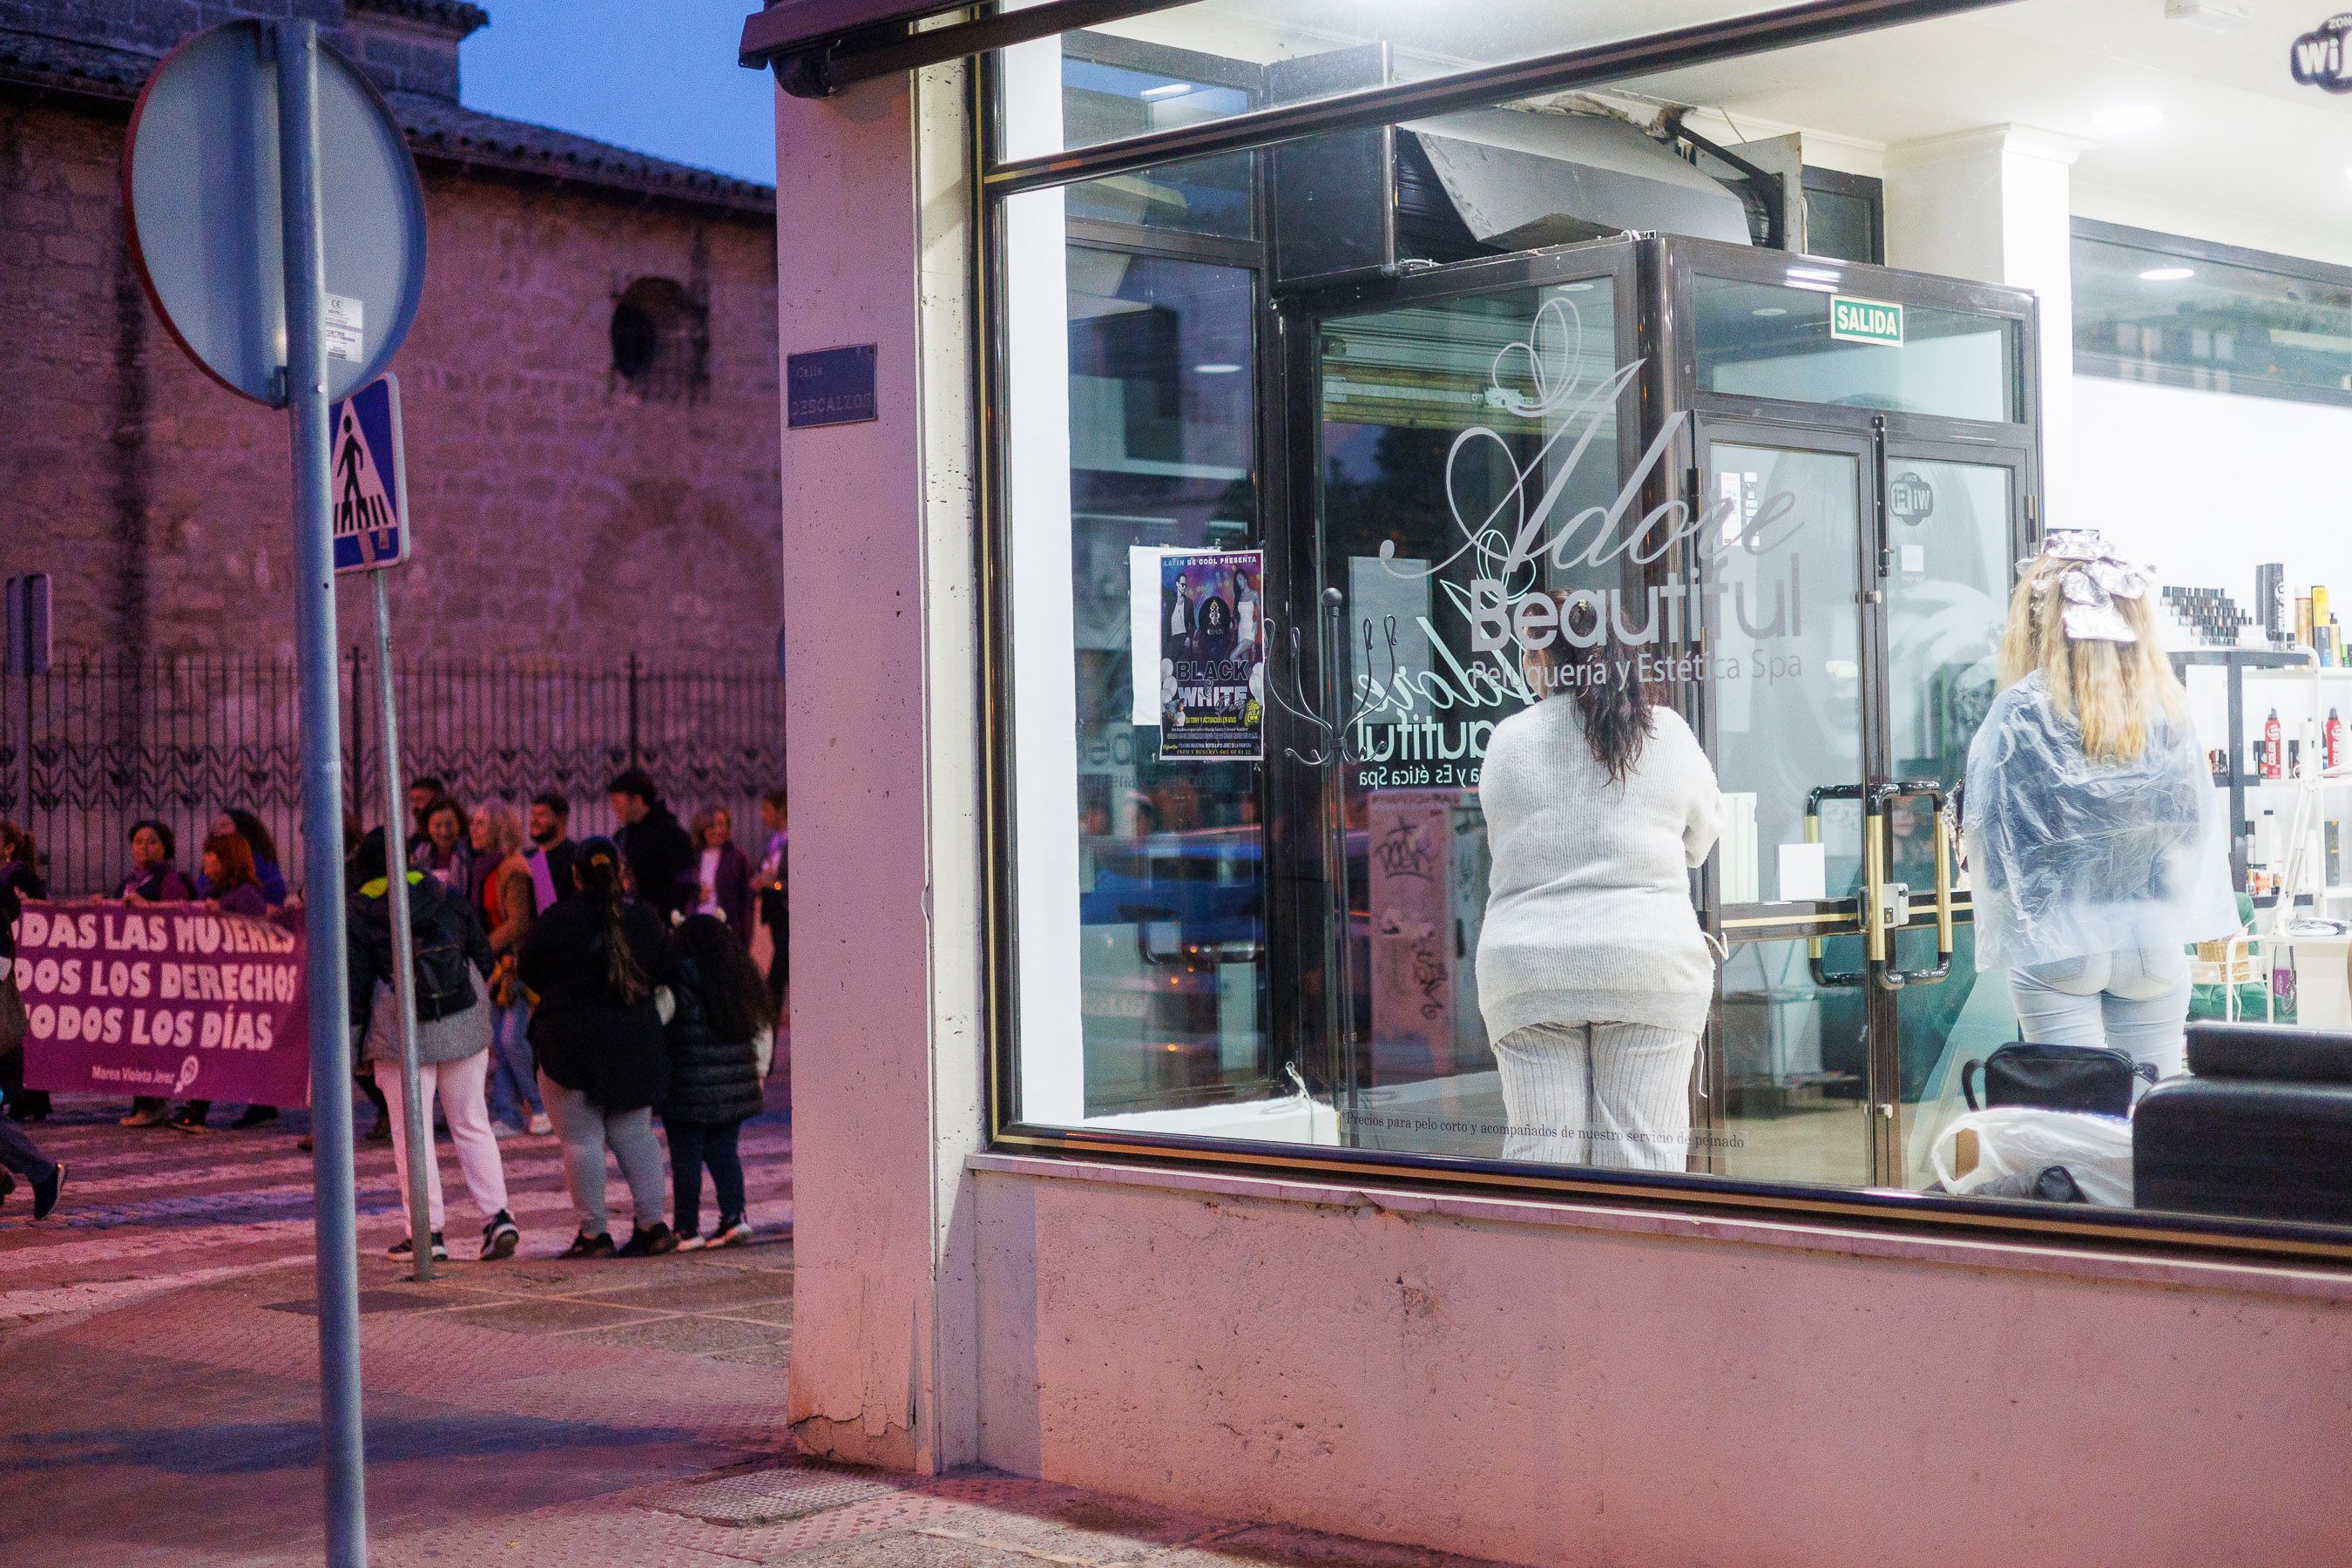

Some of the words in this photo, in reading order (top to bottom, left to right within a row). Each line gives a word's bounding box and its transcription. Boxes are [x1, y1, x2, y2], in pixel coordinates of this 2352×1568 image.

[1837, 305, 1897, 335] SALIDA
[1380, 358, 1804, 578] Adore
[1220, 556, 1257, 564] PRESENTA
[1470, 553, 1801, 652] Beautiful
[1176, 659, 1249, 682] BLACK
[1472, 655, 1607, 696] Peluquería
[1615, 659, 1632, 692] y
[1638, 650, 1741, 684] Estética
[1752, 648, 1802, 687] Spa
[1177, 686, 1247, 707] WHITE
[11, 913, 97, 950] DAS
[104, 916, 167, 952] LAS
[174, 916, 296, 954] MUJERES
[14, 958, 82, 995] DOS
[91, 961, 151, 997] LOS
[160, 962, 297, 1003] DERECHOS
[24, 1004, 124, 1044] ODOS
[131, 1009, 195, 1047] LOS
[199, 1004, 273, 1051] DÍAS
[1387, 1117, 1411, 1132] para
[1415, 1116, 1437, 1132] pelo
[1440, 1120, 1468, 1133] corto
[1470, 1125, 1477, 1136] y
[1480, 1124, 1558, 1138] acompañados
[1561, 1125, 1575, 1139] de
[1578, 1130, 1623, 1142] nuestro
[1626, 1130, 1673, 1145] servicio
[1677, 1132, 1691, 1146] de
[1694, 1134, 1745, 1150] peinado
